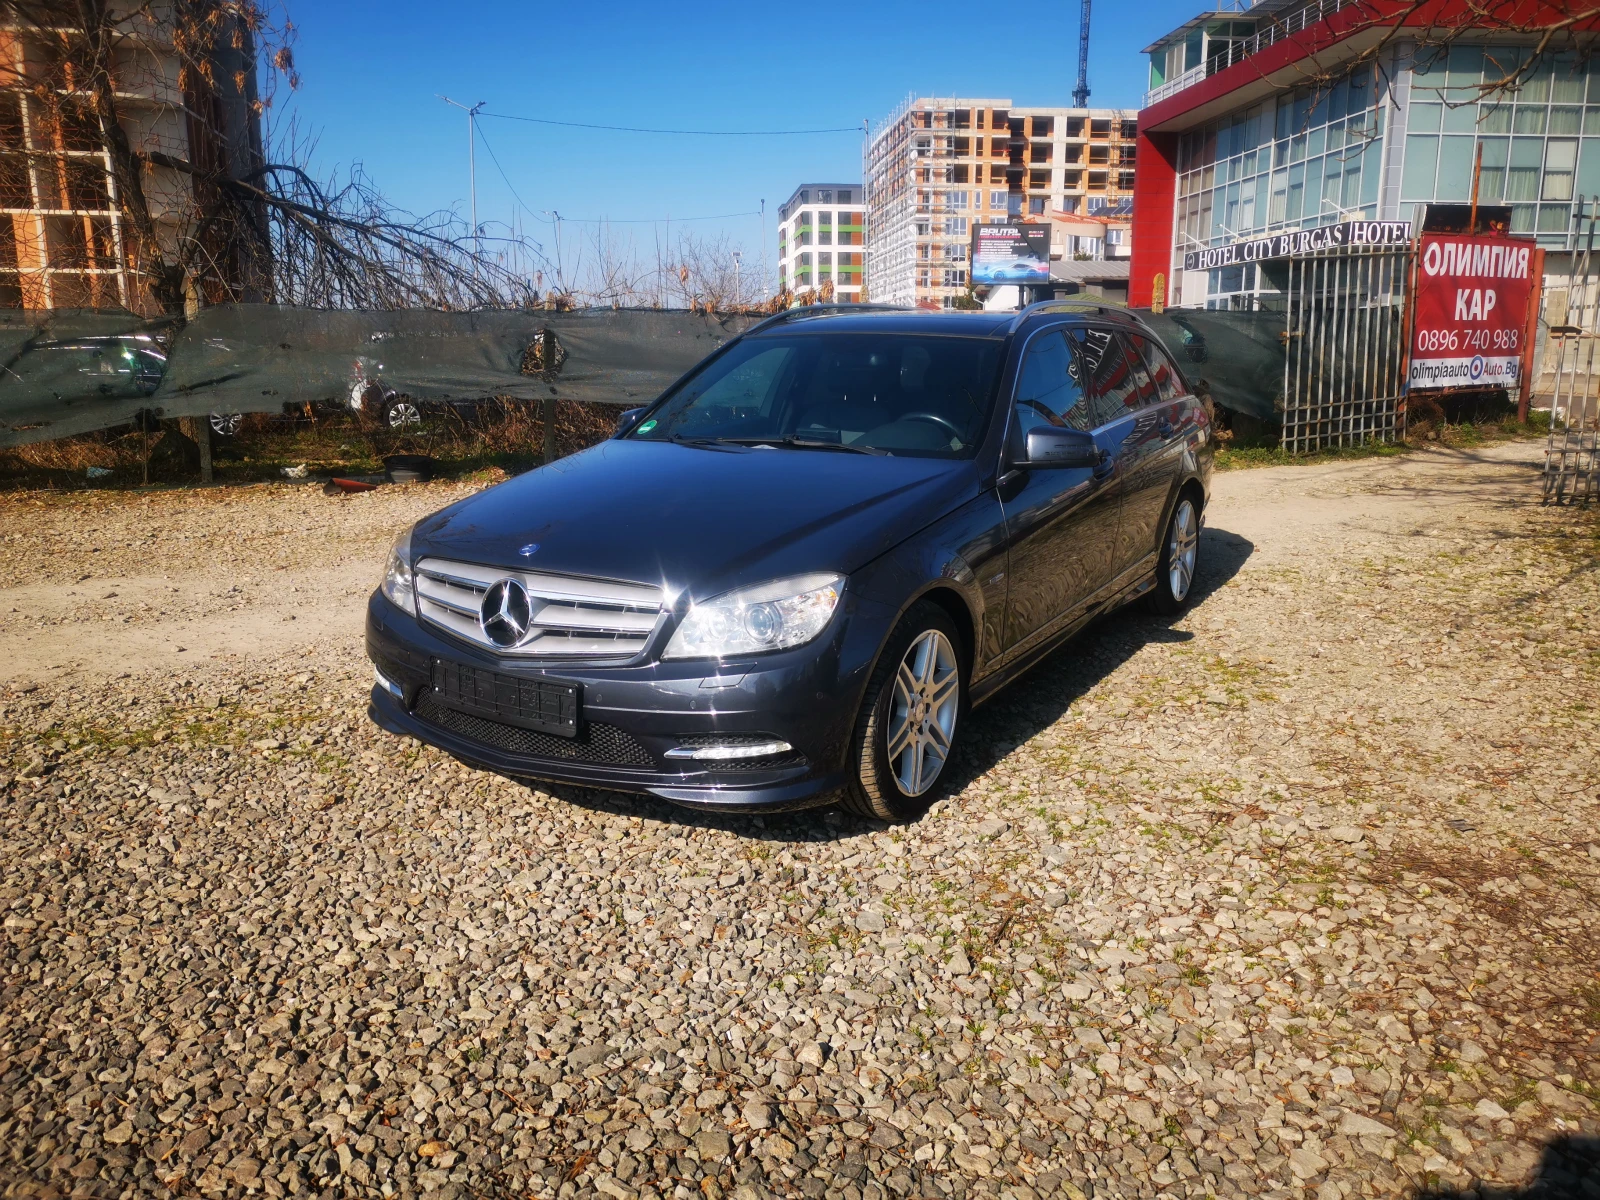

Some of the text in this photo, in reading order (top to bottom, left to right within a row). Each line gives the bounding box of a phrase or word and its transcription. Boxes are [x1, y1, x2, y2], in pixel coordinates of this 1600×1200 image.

[980, 228, 1021, 236] BRUTAL
[1353, 222, 1411, 244] HOTEL
[1199, 245, 1240, 269] HOTEL
[1243, 238, 1277, 260] CITY
[1280, 225, 1343, 254] BURGAS
[1424, 241, 1530, 279] ОЛИМПИЯ
[1454, 288, 1497, 321] КАР
[1418, 329, 1519, 351] 0896 740 988
